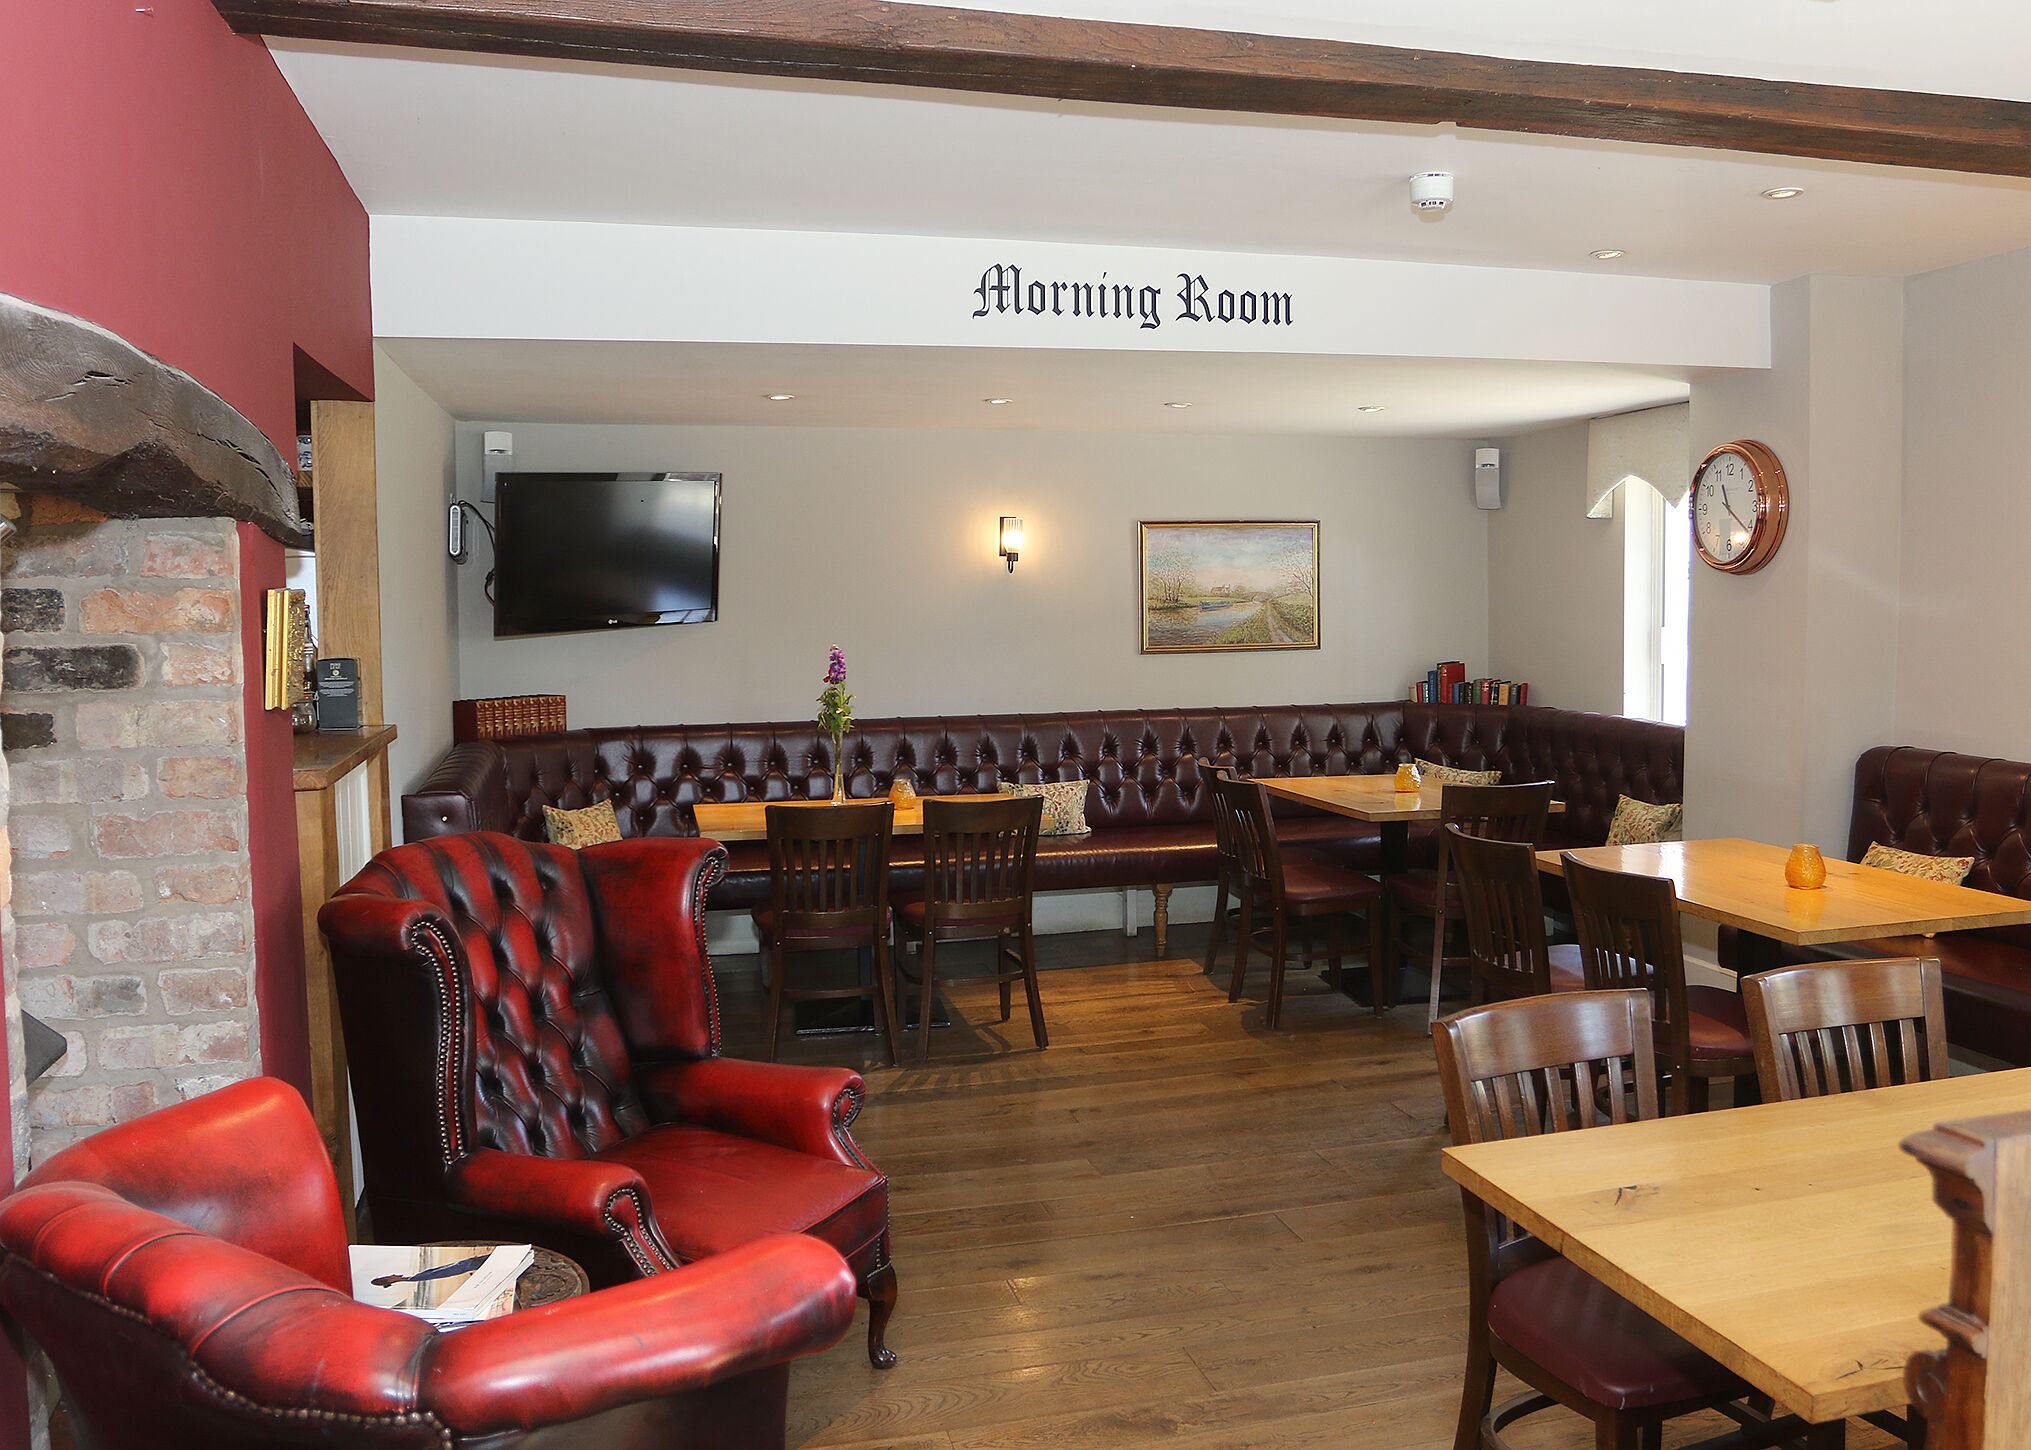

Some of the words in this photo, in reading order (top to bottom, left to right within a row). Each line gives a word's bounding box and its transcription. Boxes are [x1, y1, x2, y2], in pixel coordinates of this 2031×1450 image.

[972, 263, 1161, 330] Morning
[1175, 271, 1294, 326] Room
[1714, 469, 1722, 482] 11
[1726, 463, 1734, 476] 12
[1739, 467, 1744, 480] 1
[1705, 484, 1715, 497] 10
[1748, 479, 1754, 492] 2
[1702, 503, 1708, 516] 9
[1752, 500, 1758, 513] 3
[1706, 521, 1711, 534] 8
[1747, 519, 1753, 531] 4
[1715, 534, 1720, 547] 7
[1726, 538, 1732, 551] 6
